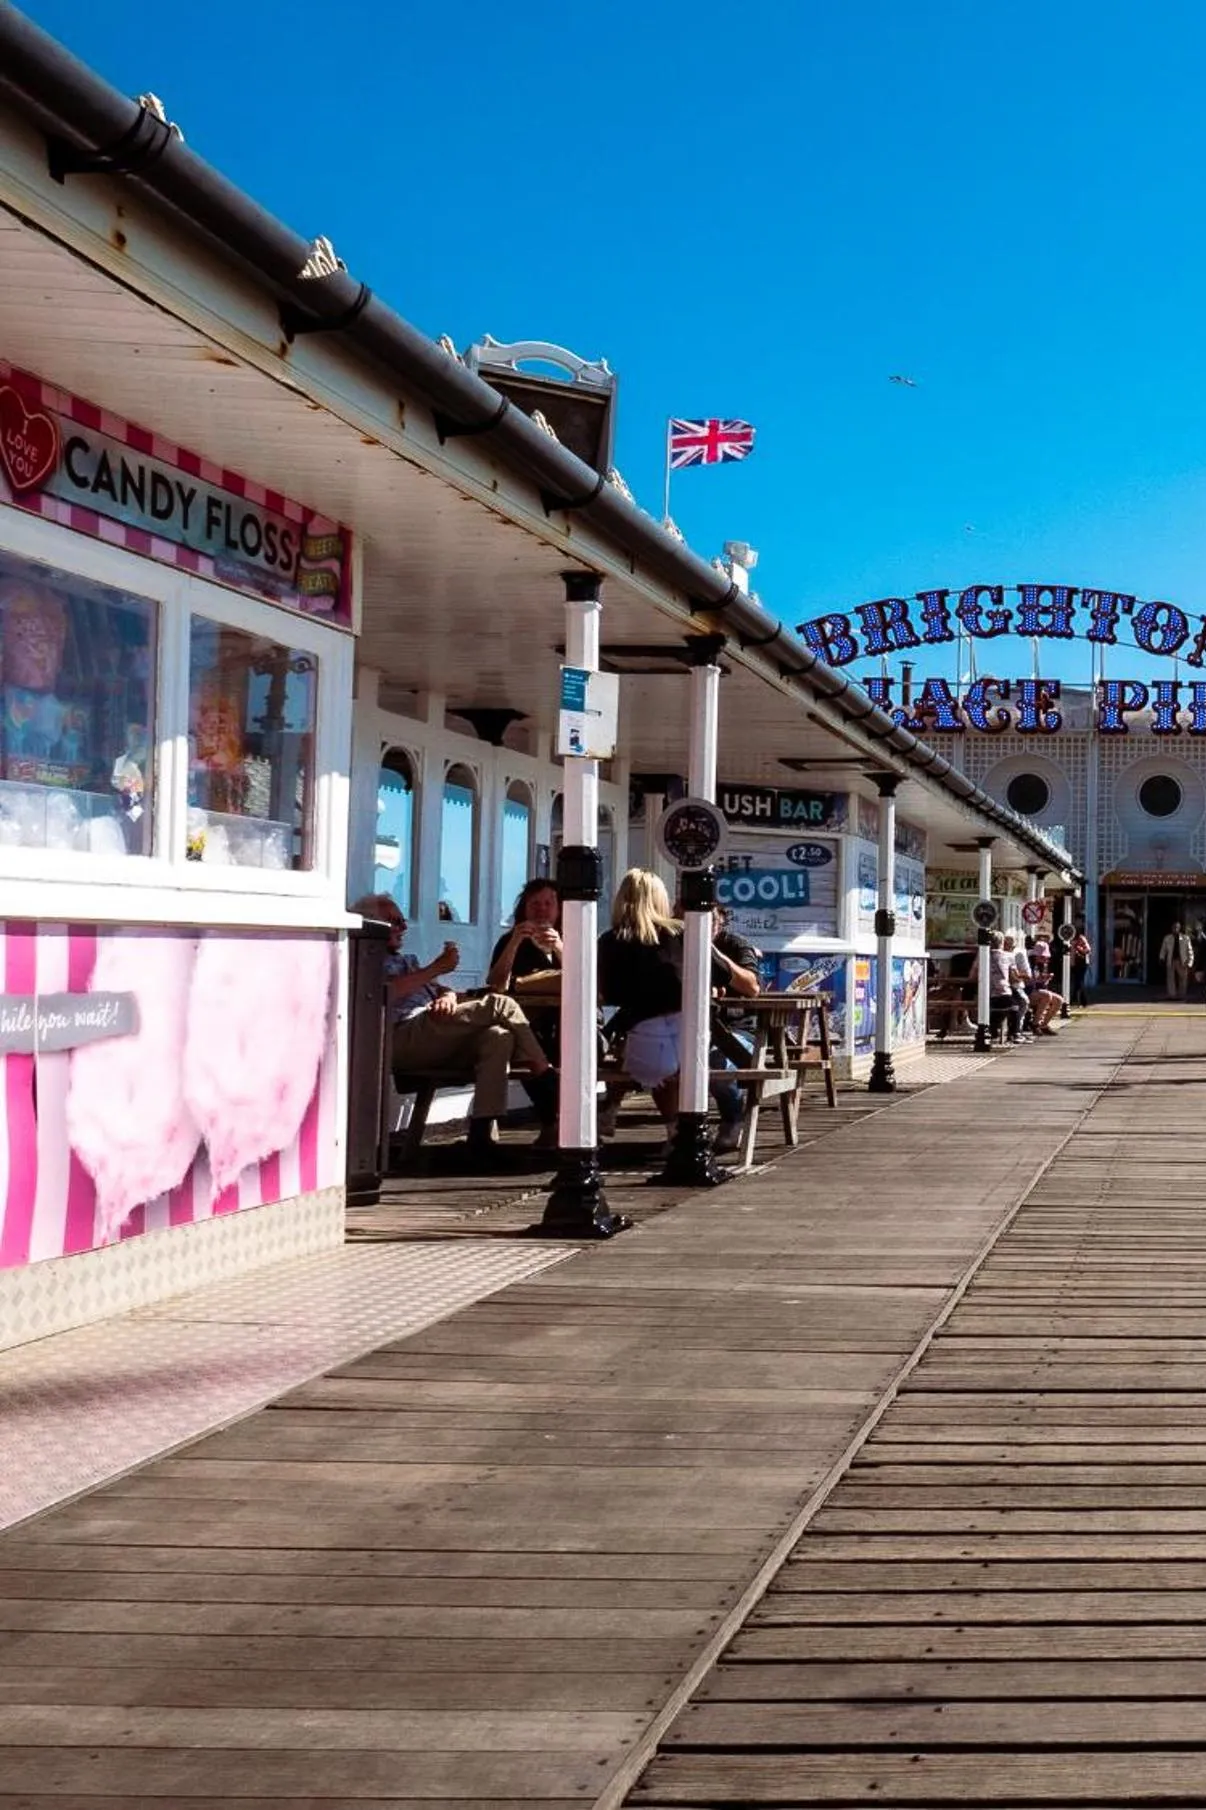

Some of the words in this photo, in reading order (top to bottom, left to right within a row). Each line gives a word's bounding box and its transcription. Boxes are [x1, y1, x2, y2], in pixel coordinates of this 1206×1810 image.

[22, 418, 29, 435] I
[6, 428, 38, 463] LOVE
[8, 449, 34, 478] YOU
[63, 435, 197, 531] CANDY
[205, 495, 295, 572] FLOSS
[862, 676, 1062, 735] LACE
[723, 793, 772, 817] USH
[779, 797, 824, 821] BAR
[715, 873, 806, 903] COOL!
[0, 1003, 33, 1033] hile
[37, 1012, 70, 1043] you
[74, 999, 121, 1028] wait!
